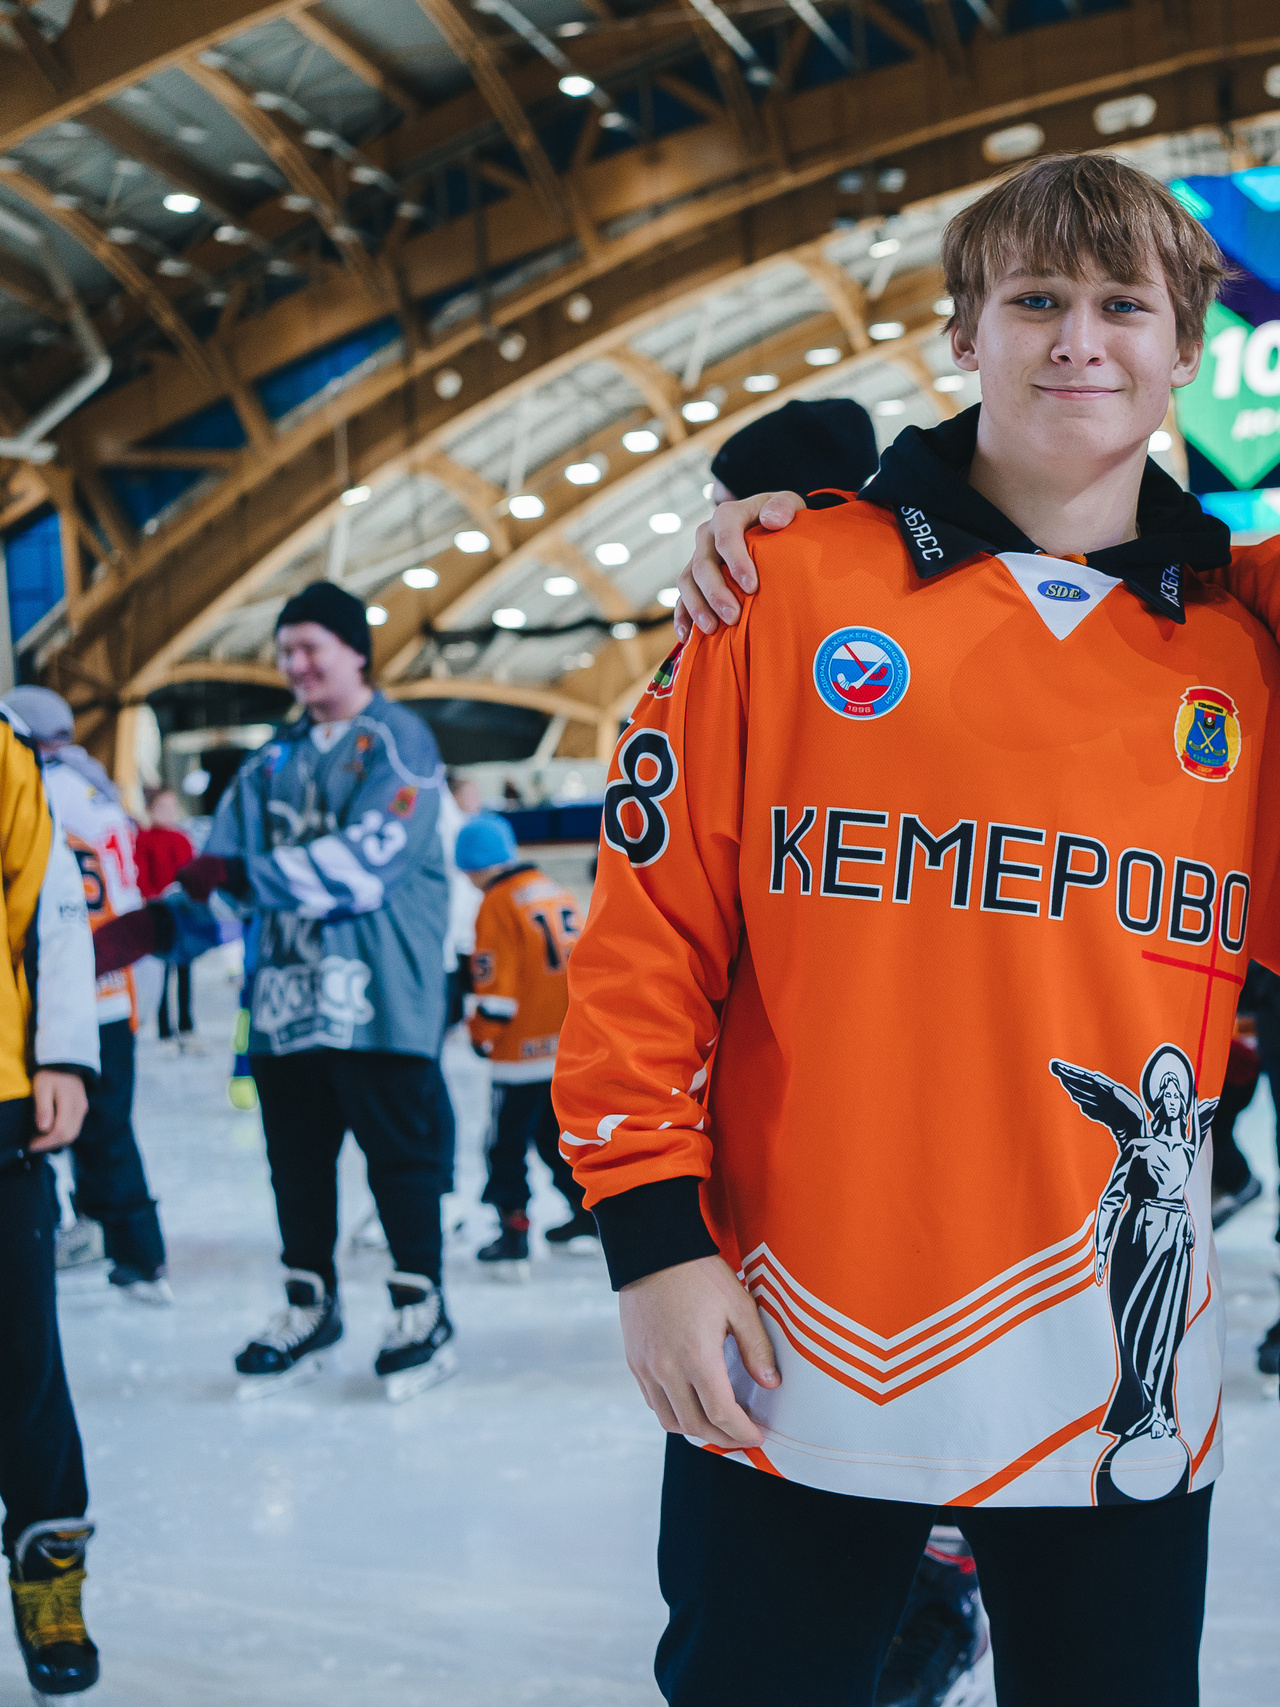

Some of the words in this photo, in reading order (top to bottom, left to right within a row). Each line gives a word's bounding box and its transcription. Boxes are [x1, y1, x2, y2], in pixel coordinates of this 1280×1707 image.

[900, 505, 944, 561] ЗБАСС
[1045, 583, 1081, 600] SDE
[602, 722, 679, 869] 8
[769, 806, 1251, 954] КЕМЕРОВО
